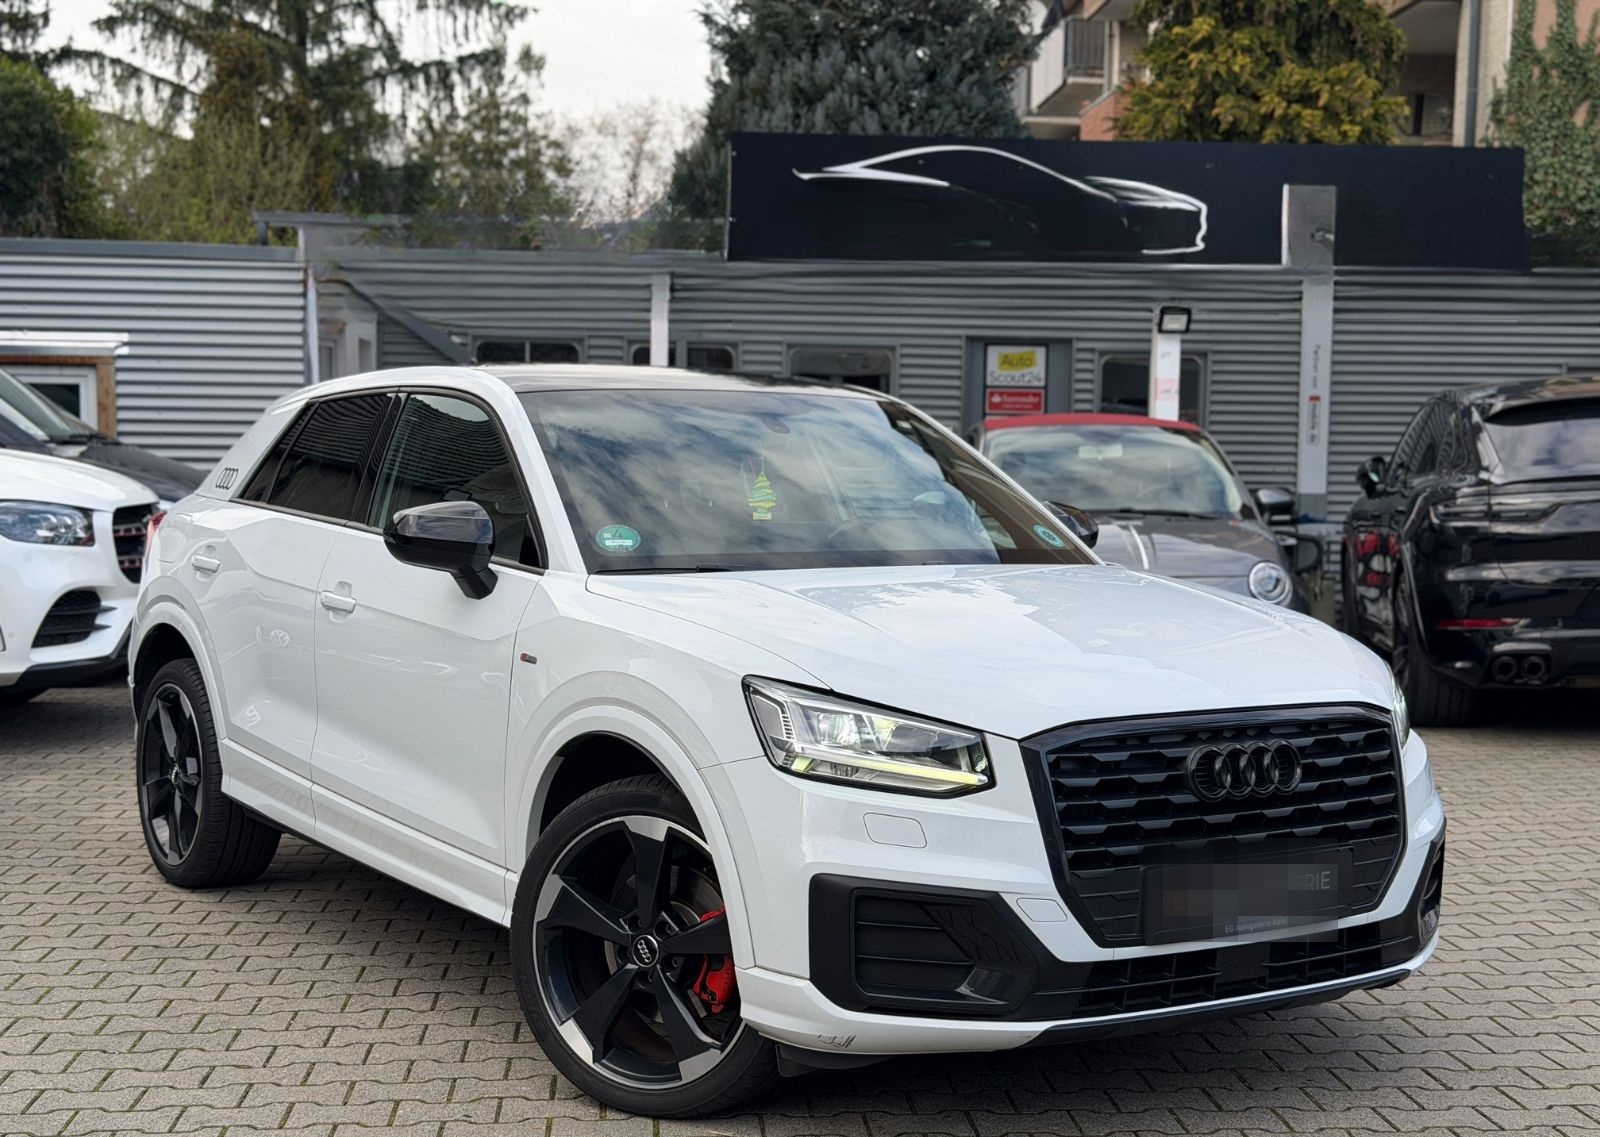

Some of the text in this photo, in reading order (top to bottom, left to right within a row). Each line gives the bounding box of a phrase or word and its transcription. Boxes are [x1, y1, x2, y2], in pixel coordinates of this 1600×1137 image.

[1000, 353, 1033, 369] Auto
[989, 371, 1042, 384] Scout24
[1225, 917, 1288, 934] EG Autogalerie Köln
